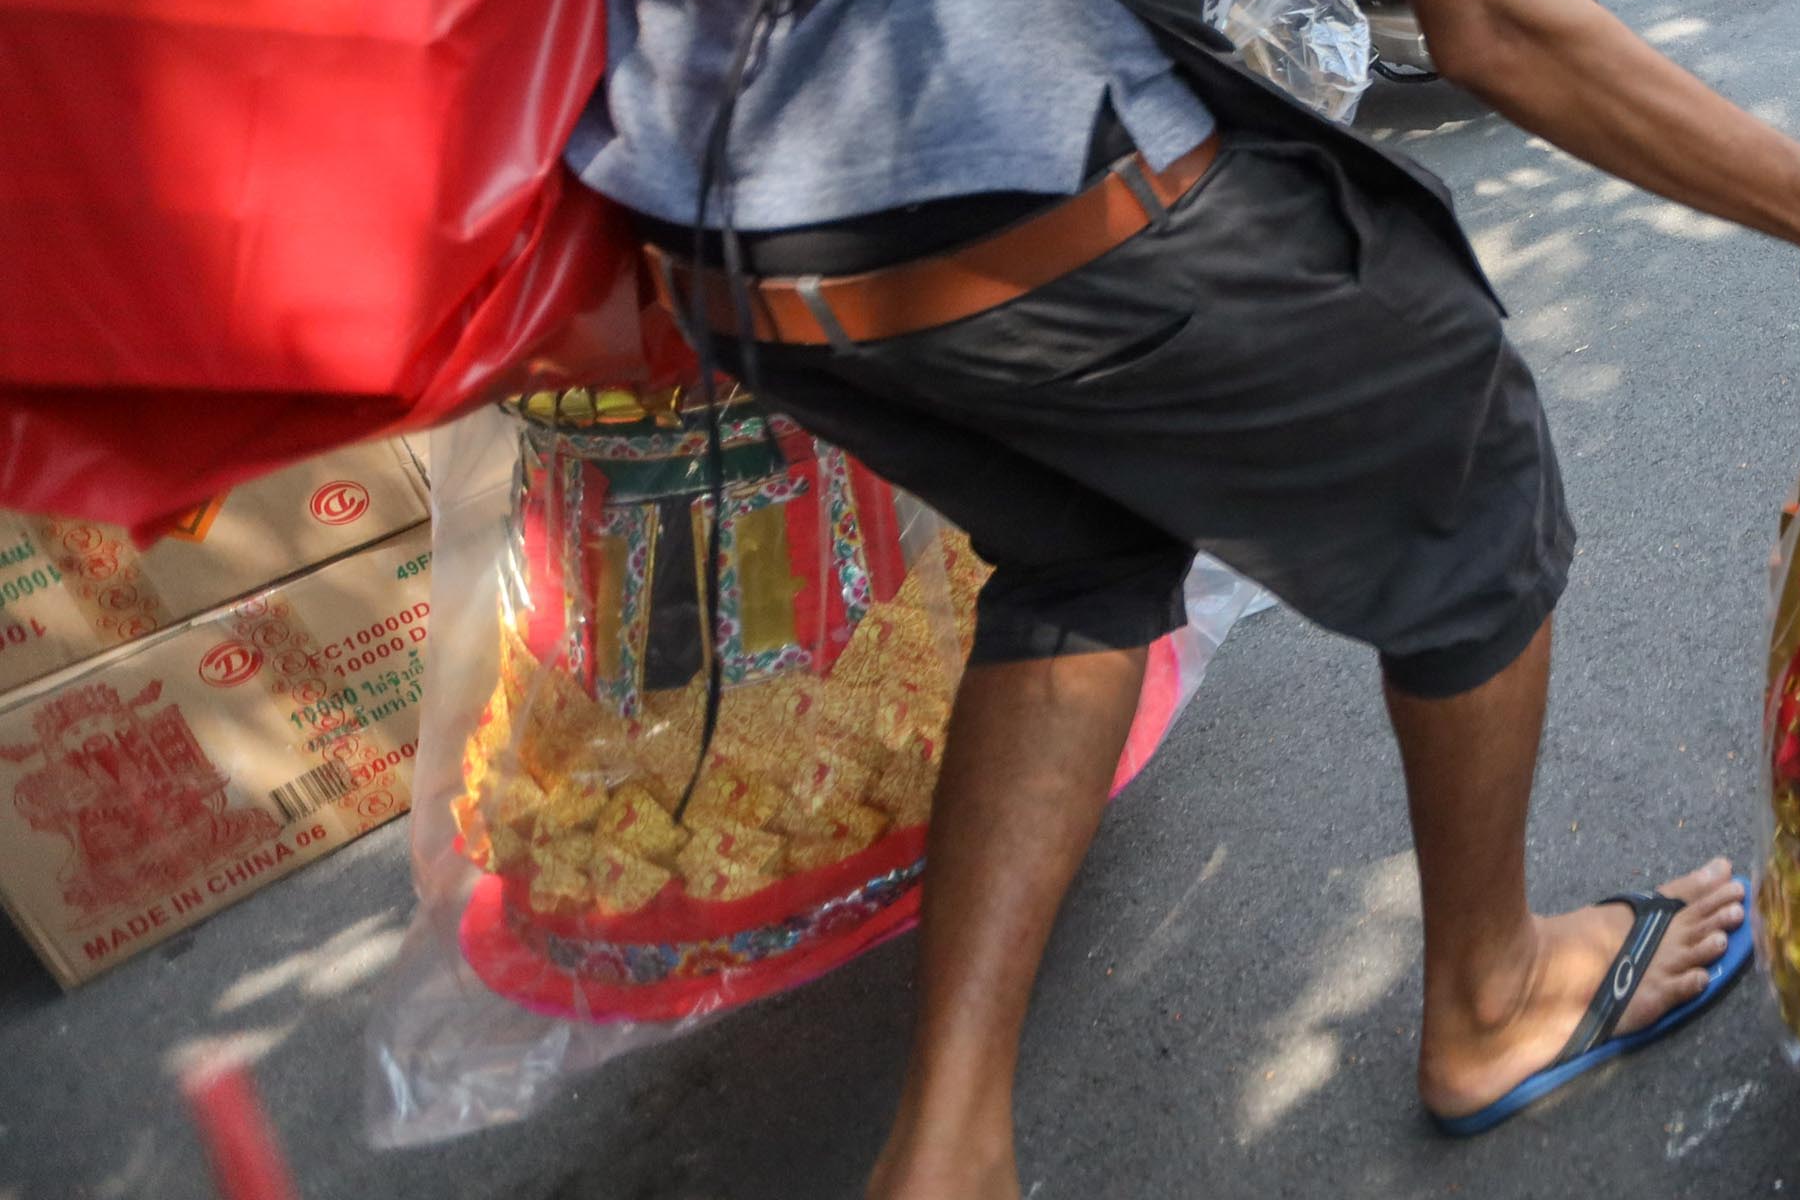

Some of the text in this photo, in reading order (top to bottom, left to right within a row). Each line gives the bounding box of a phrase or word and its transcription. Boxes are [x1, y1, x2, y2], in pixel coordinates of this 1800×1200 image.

[396, 552, 432, 582] 49F
[334, 625, 427, 678] 10000 D
[290, 687, 358, 730] 10000
[83, 823, 327, 960] MADE IN CHINA 06
